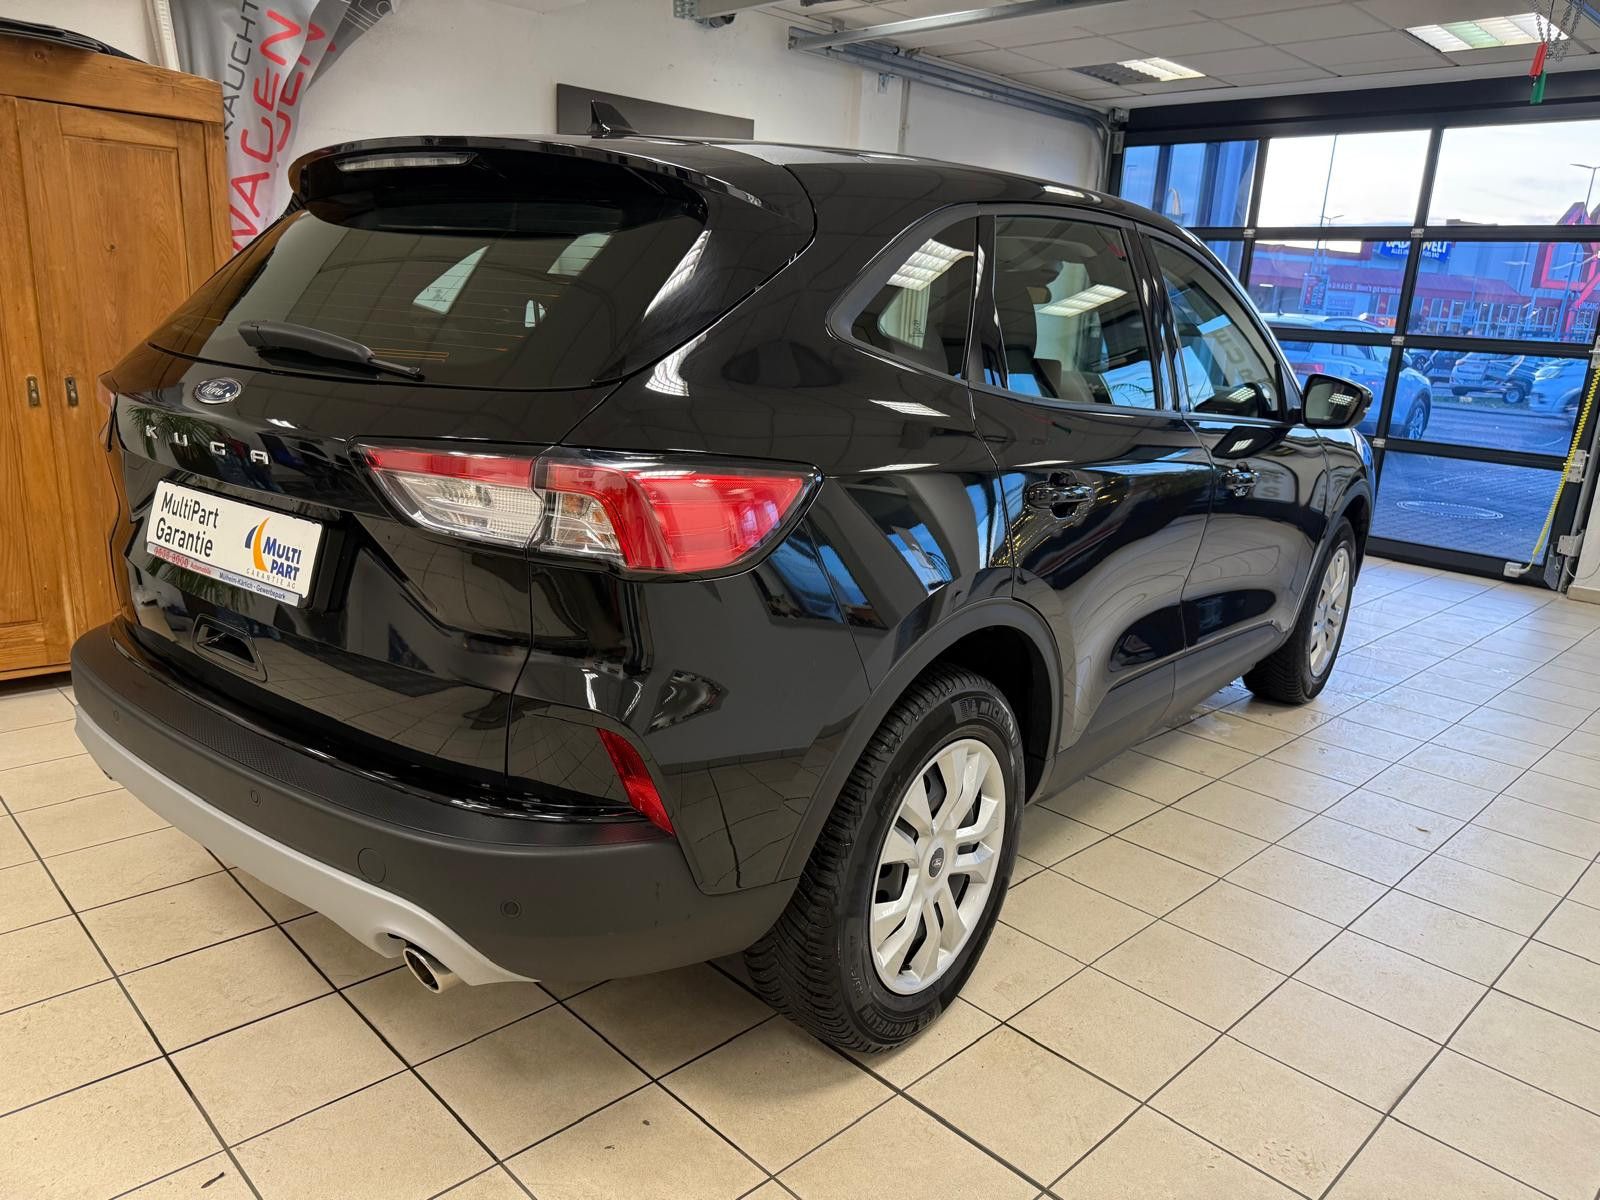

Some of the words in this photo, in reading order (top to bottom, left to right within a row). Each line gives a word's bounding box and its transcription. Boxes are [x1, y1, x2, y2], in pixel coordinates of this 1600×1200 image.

[145, 424, 270, 466] KUGA
[160, 491, 220, 530] MultiPart
[155, 518, 214, 558] Garantie
[262, 535, 302, 565] MULTI
[269, 563, 301, 582] PART
[286, 580, 296, 590] AG
[255, 584, 287, 601] Gewerbepark
